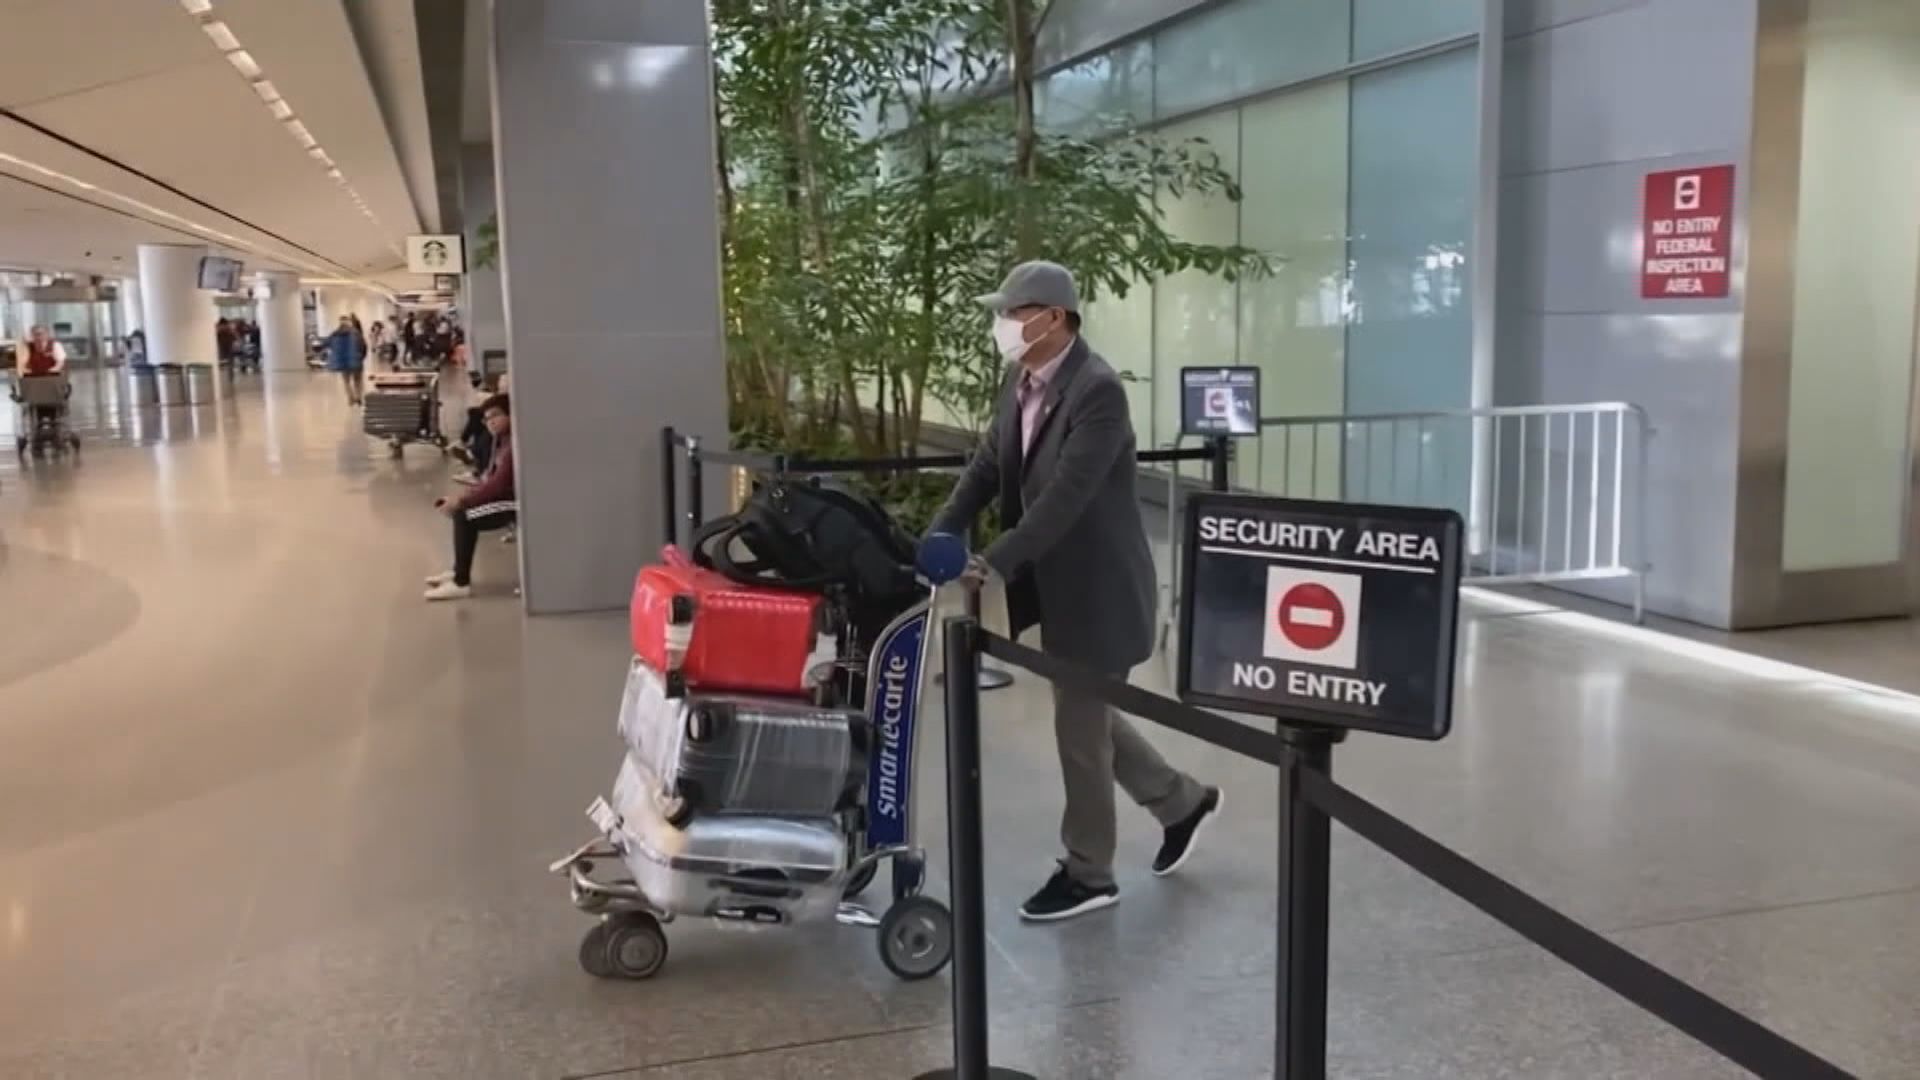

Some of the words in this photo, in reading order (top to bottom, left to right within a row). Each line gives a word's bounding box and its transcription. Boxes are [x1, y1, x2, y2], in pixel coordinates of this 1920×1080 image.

[1652, 221, 1673, 234] NO
[1676, 217, 1720, 233] ENTRY
[1656, 238, 1715, 254] FEDERAL
[1647, 258, 1724, 273] INSPECTION
[1665, 278, 1703, 292] AREA
[1199, 516, 1344, 551] SECURITY
[1355, 531, 1440, 561] AREA
[1232, 662, 1275, 690] NO
[1287, 671, 1386, 706] ENTRY
